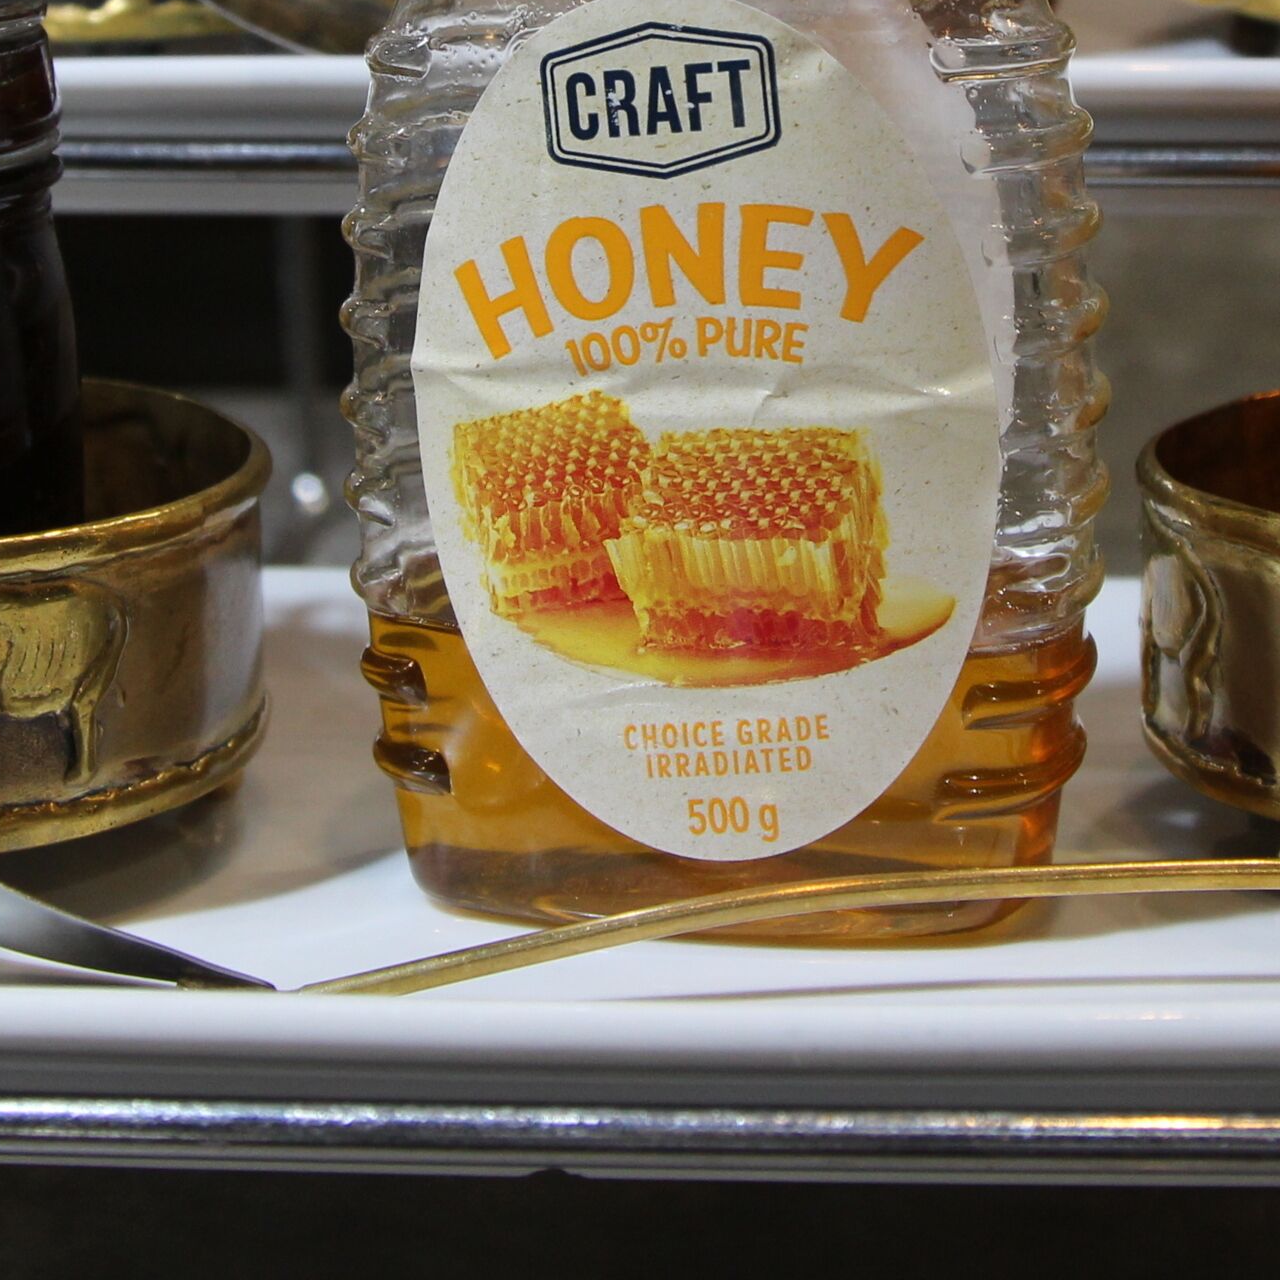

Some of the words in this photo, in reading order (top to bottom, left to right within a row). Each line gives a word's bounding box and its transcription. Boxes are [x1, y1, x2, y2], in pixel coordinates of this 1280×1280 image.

[564, 59, 751, 141] CRAFT
[453, 202, 925, 360] HONEY
[564, 317, 688, 377] 100%
[696, 317, 809, 365] PURE
[623, 721, 725, 751] CHOICE
[736, 714, 830, 746] GRADE
[645, 745, 813, 779] IRRADIATED
[687, 795, 749, 835] 500
[758, 803, 780, 842] g
